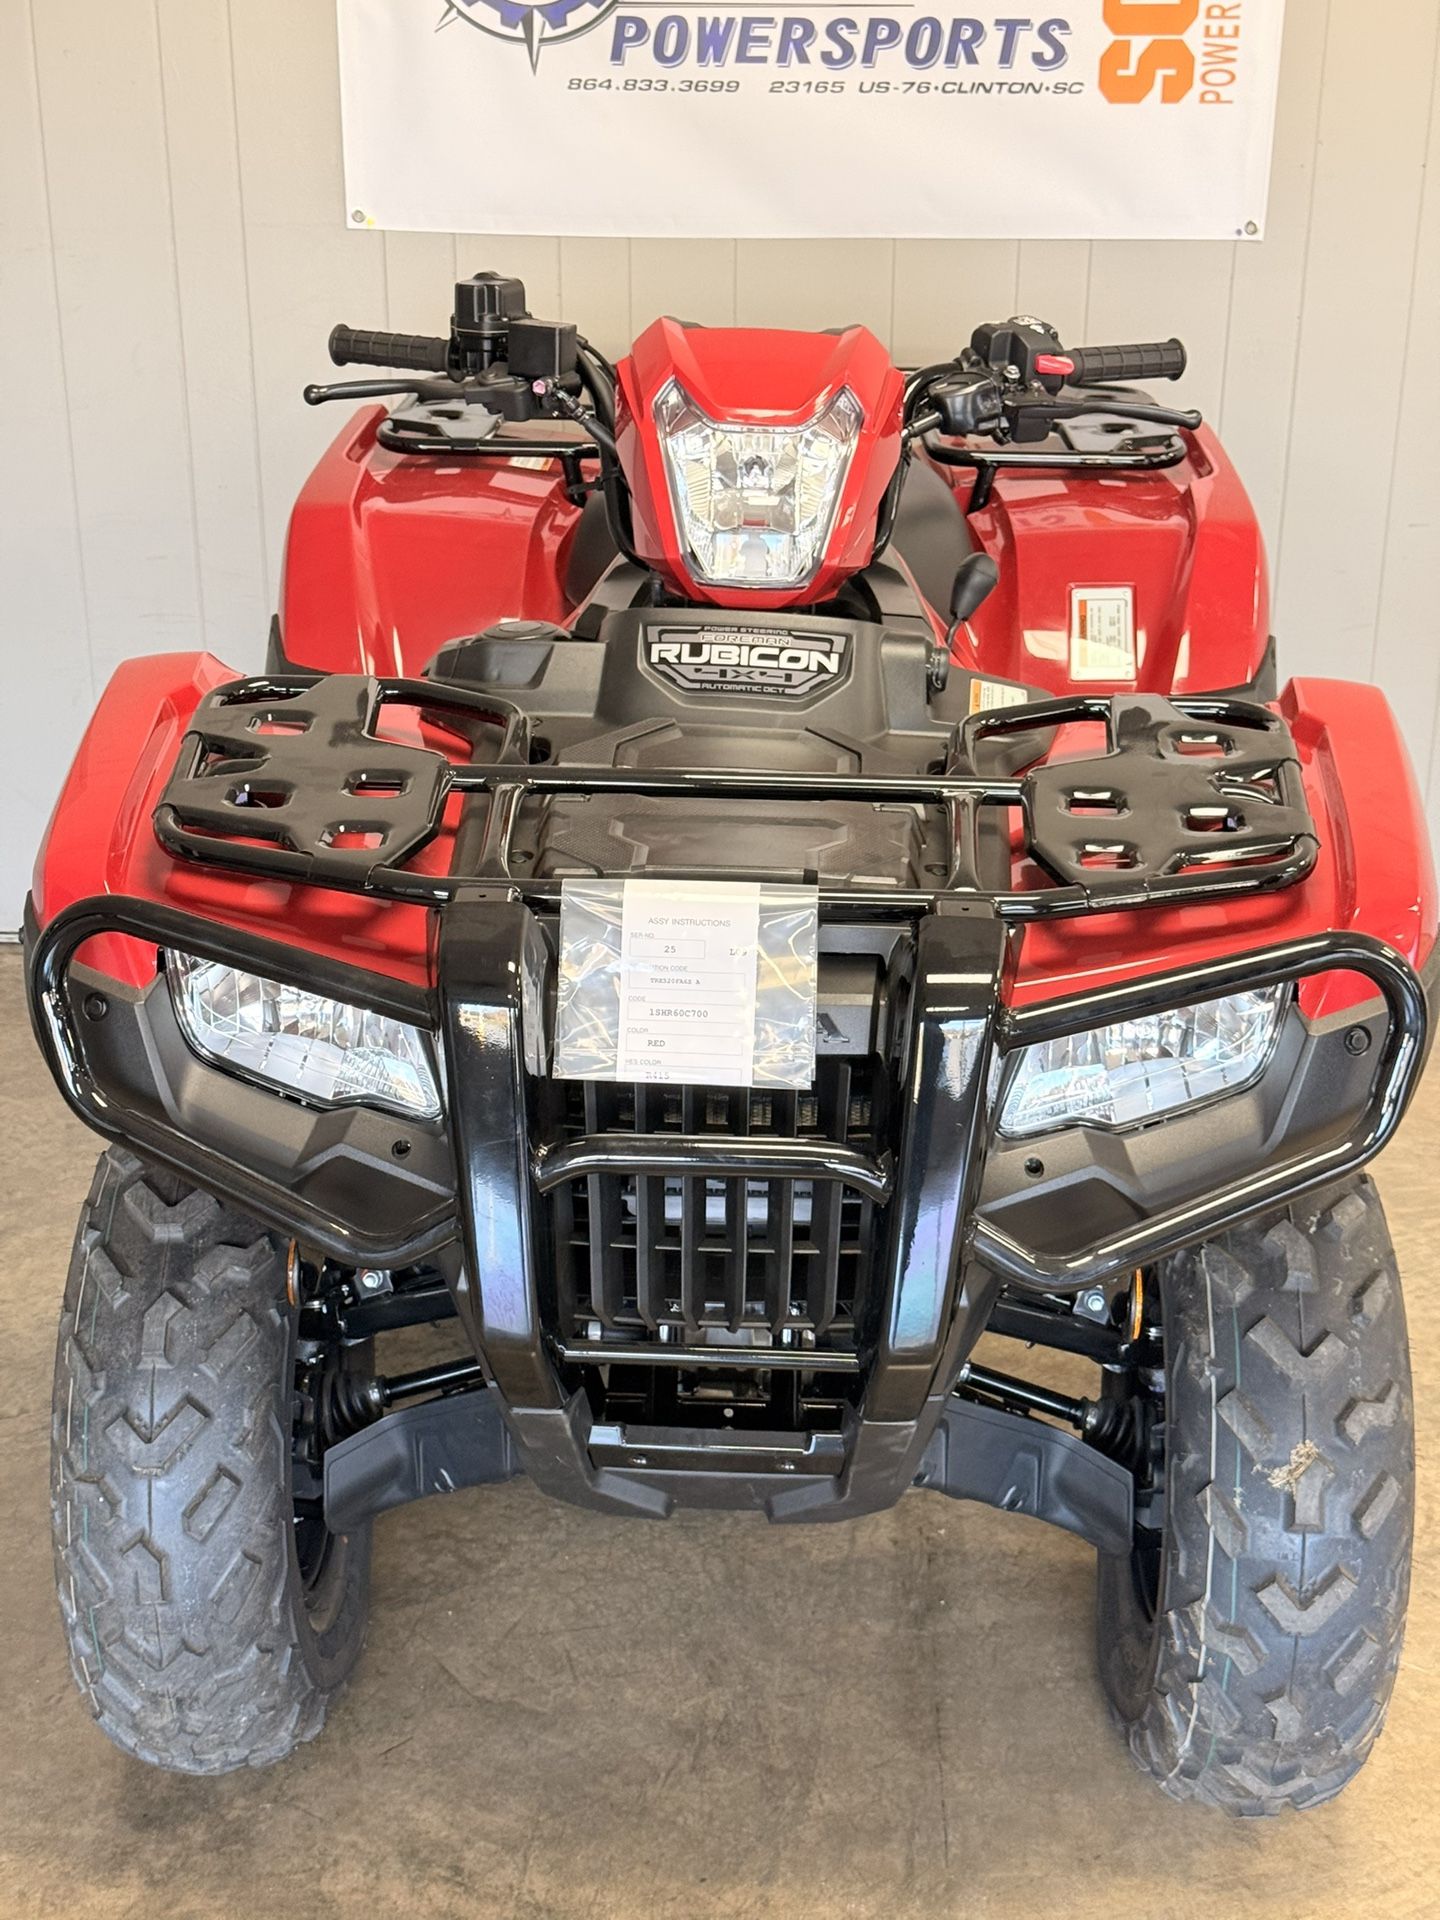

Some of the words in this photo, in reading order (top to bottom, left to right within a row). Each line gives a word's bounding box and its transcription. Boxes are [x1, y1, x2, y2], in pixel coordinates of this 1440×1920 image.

[608, 15, 1070, 71] POWERSPORTS
[1199, 2, 1241, 104] POWER
[566, 78, 740, 93] 864.833.3699
[768, 81, 845, 94] 23165
[703, 625, 737, 633] POWER
[740, 627, 789, 636] STEERING
[701, 634, 791, 647] FOREMAN
[650, 642, 839, 674] RUBICON
[701, 682, 762, 693] AUTOMATIC
[763, 686, 787, 694] DCT
[648, 917, 670, 926] ASSY
[671, 918, 731, 928] INSTRUCTIONS
[664, 945, 676, 954] 25
[647, 1039, 666, 1047] RED
